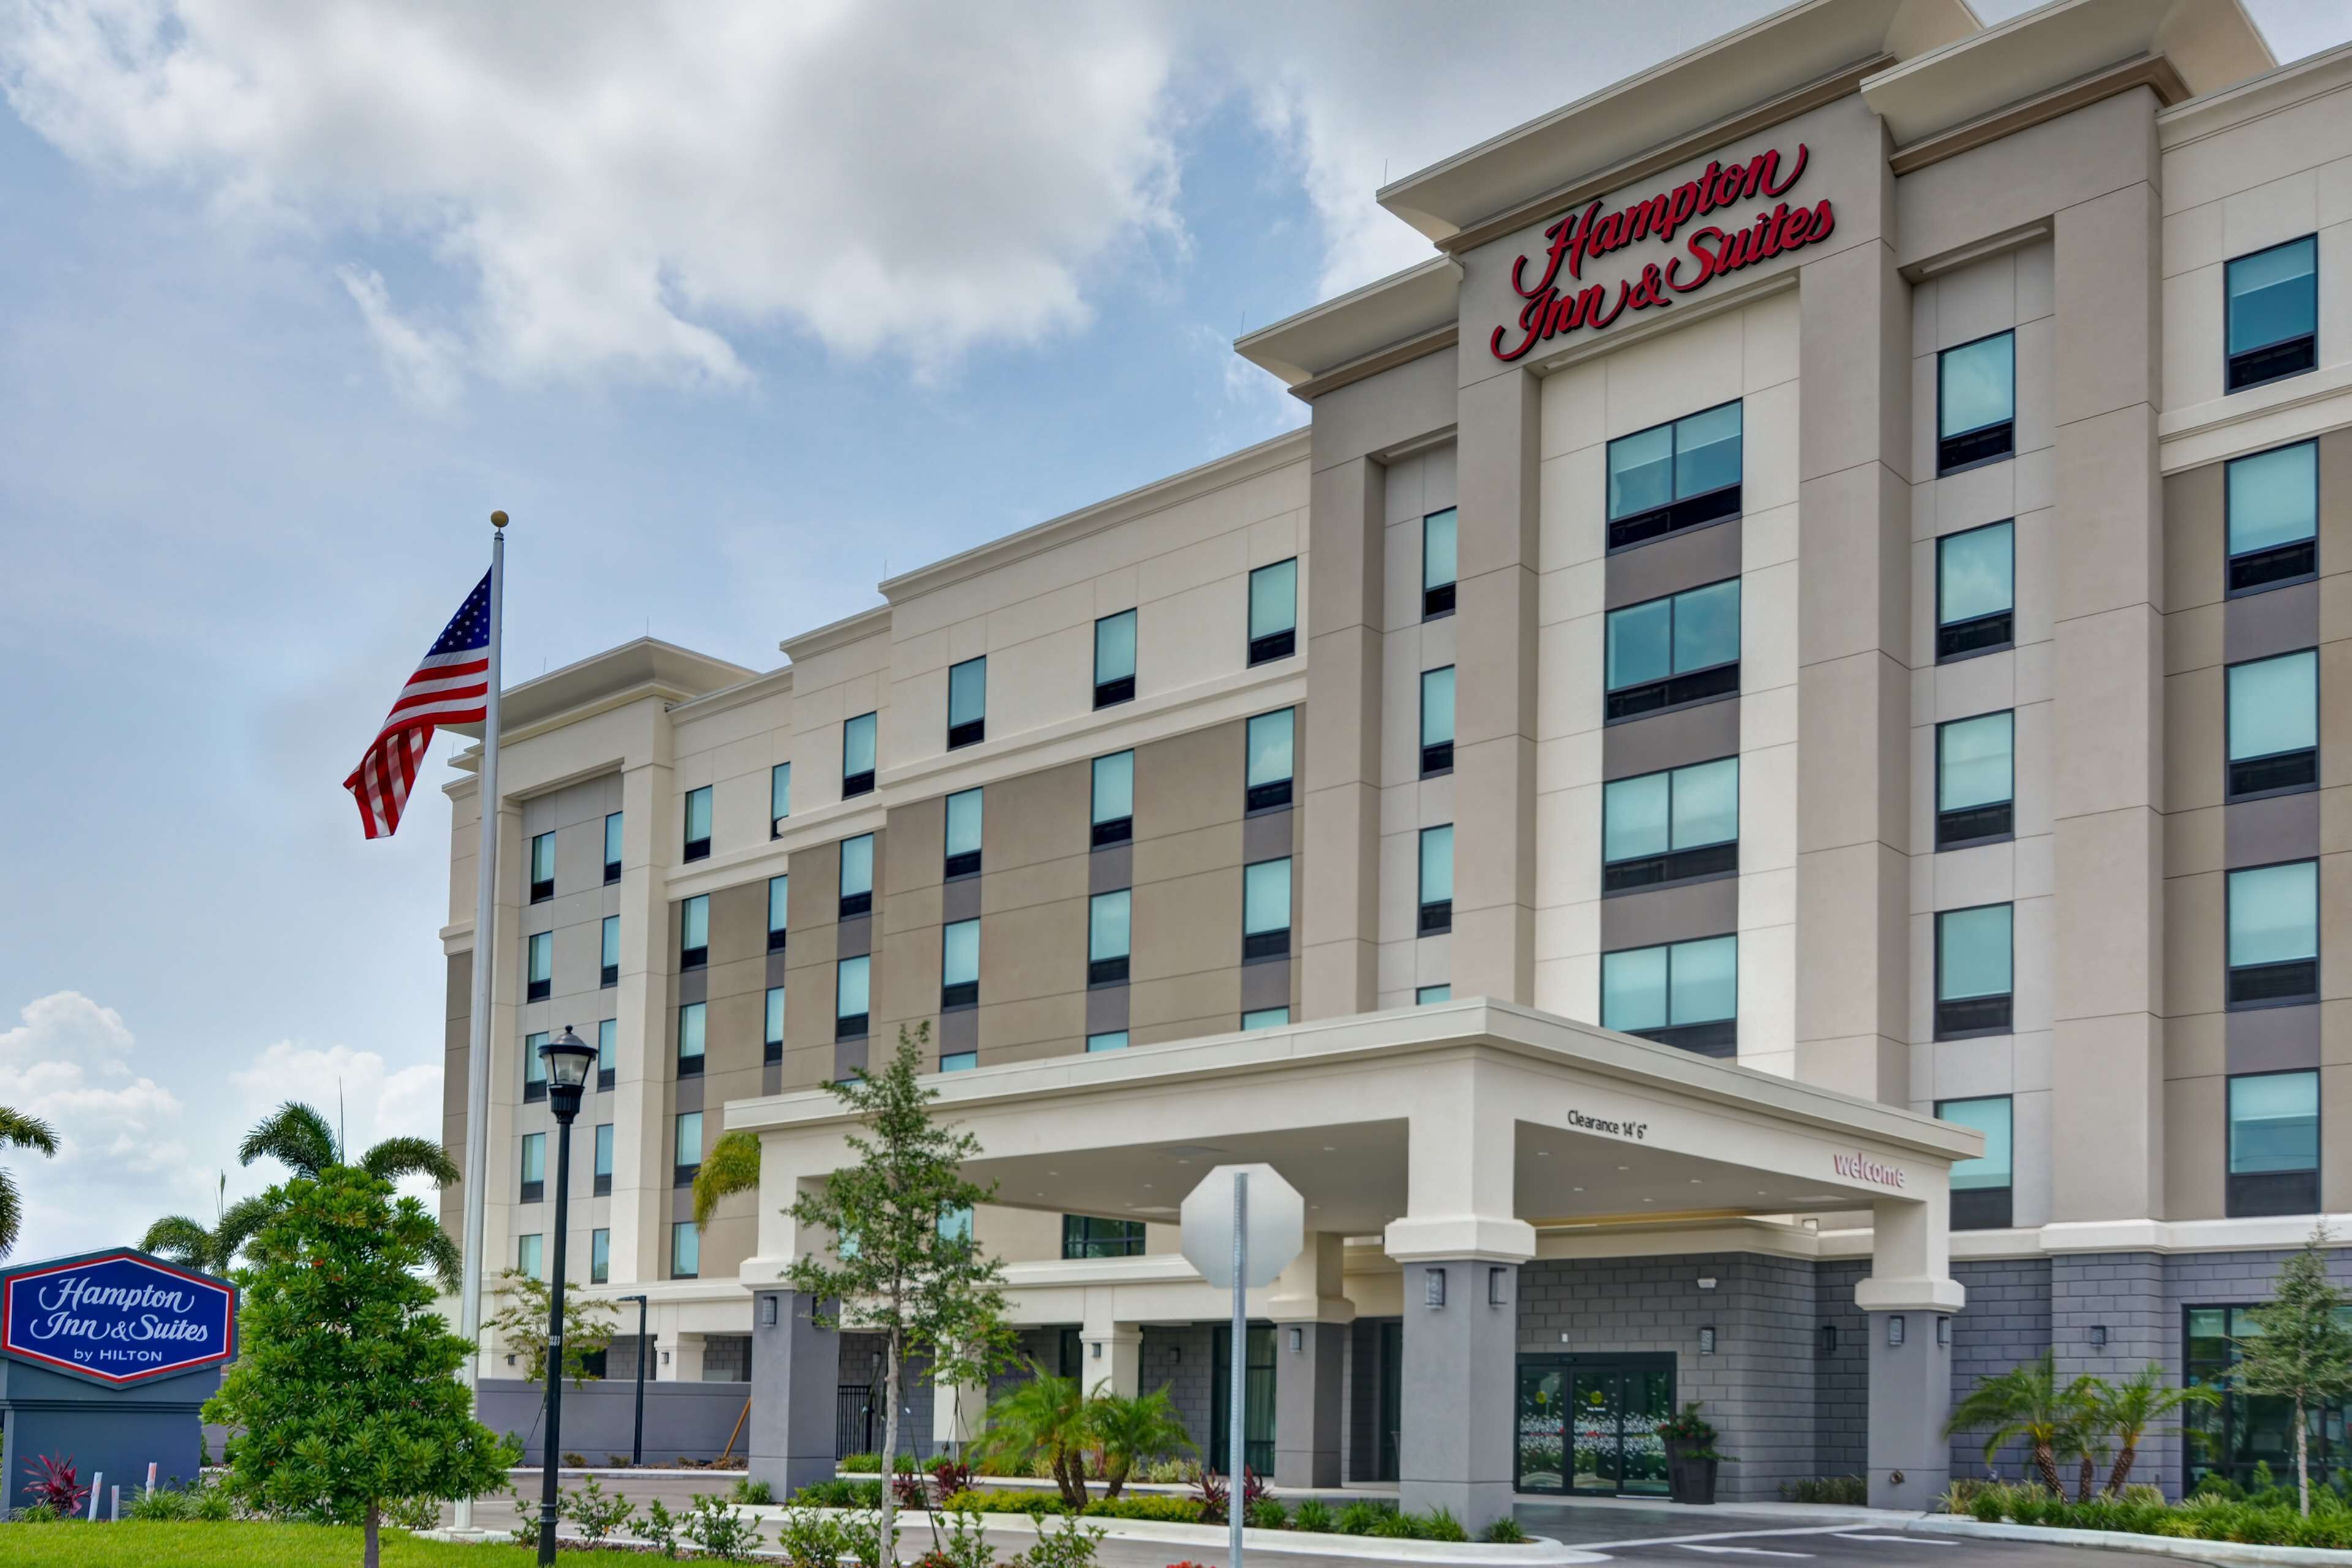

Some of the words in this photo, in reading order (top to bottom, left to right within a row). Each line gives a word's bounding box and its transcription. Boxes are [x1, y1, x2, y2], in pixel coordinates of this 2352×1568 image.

[1512, 143, 1808, 299] Hampton
[1491, 279, 1630, 361] Inn
[1627, 263, 1672, 309] &
[1665, 200, 1834, 293] Suites
[1567, 1109, 1619, 1134] Clearance
[1833, 1152, 1906, 1188] welcome
[39, 1277, 195, 1313] Hampton
[30, 1311, 111, 1340] Inn
[111, 1321, 130, 1341] &
[129, 1314, 208, 1342] Suites
[74, 1348, 93, 1362] by
[100, 1349, 162, 1362] HILTON
